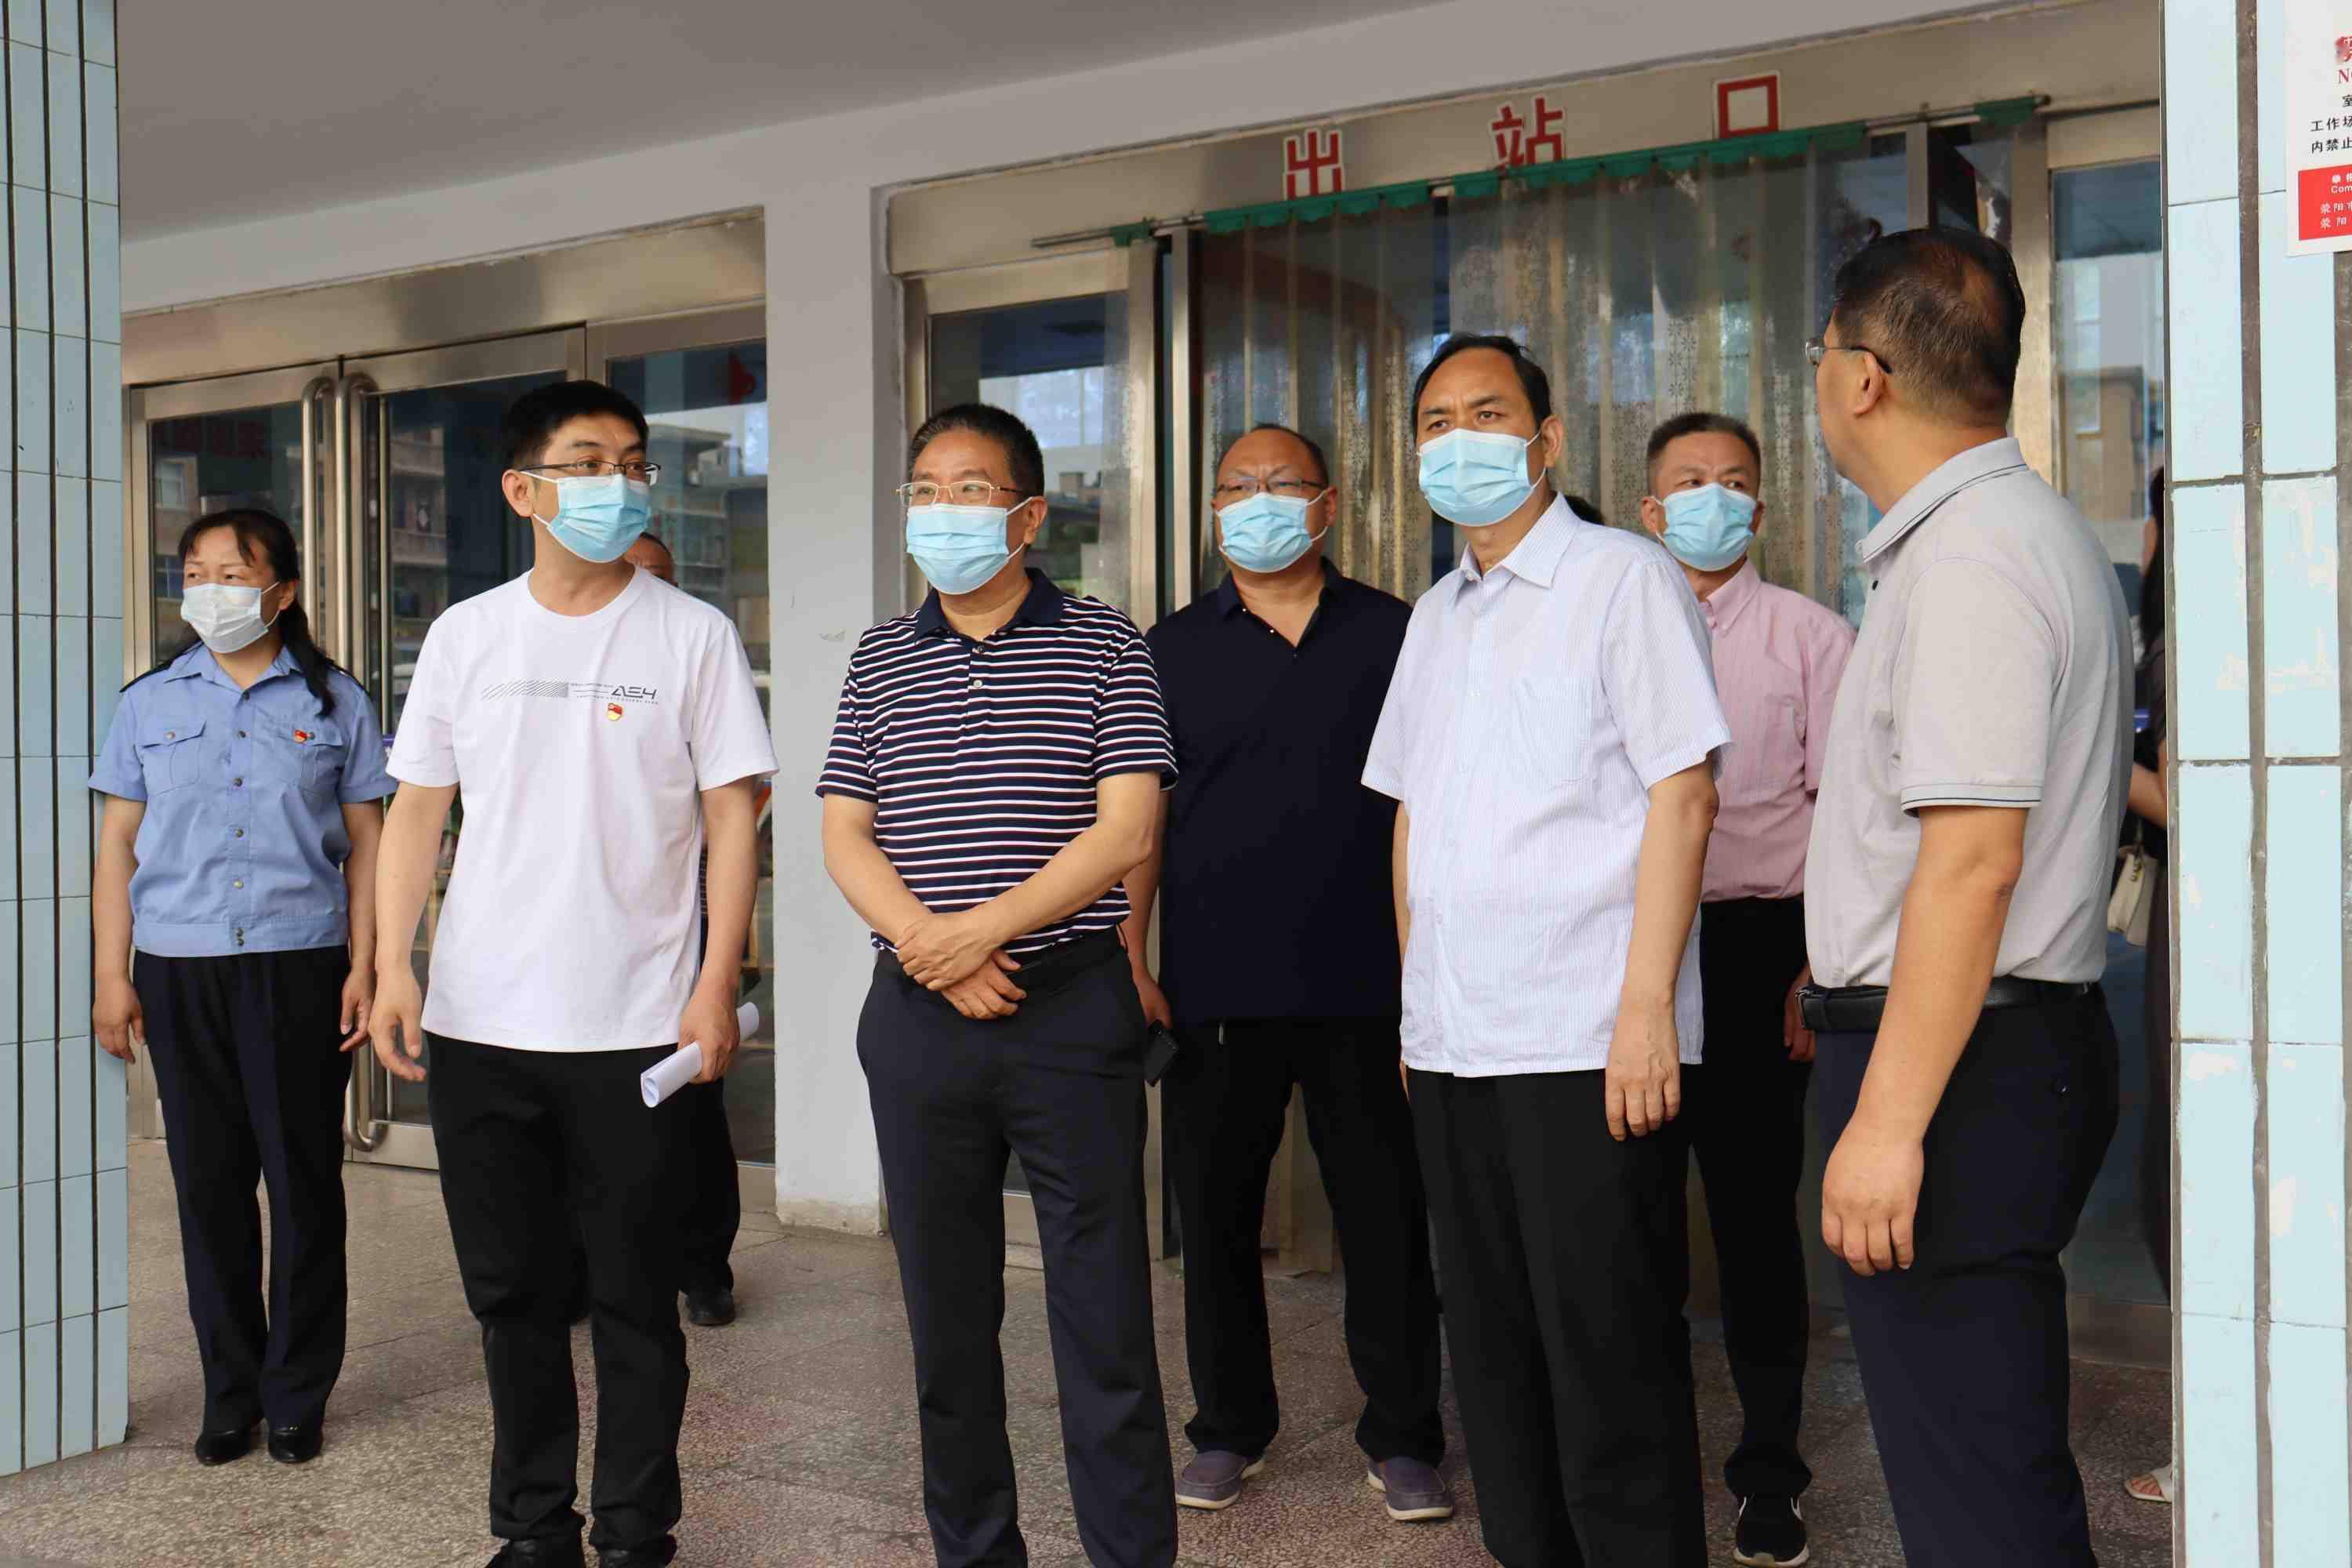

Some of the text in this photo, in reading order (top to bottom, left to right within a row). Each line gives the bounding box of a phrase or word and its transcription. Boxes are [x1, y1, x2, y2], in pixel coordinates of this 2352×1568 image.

[2338, 68, 2352, 84] N
[1286, 74, 1779, 199] 出站口
